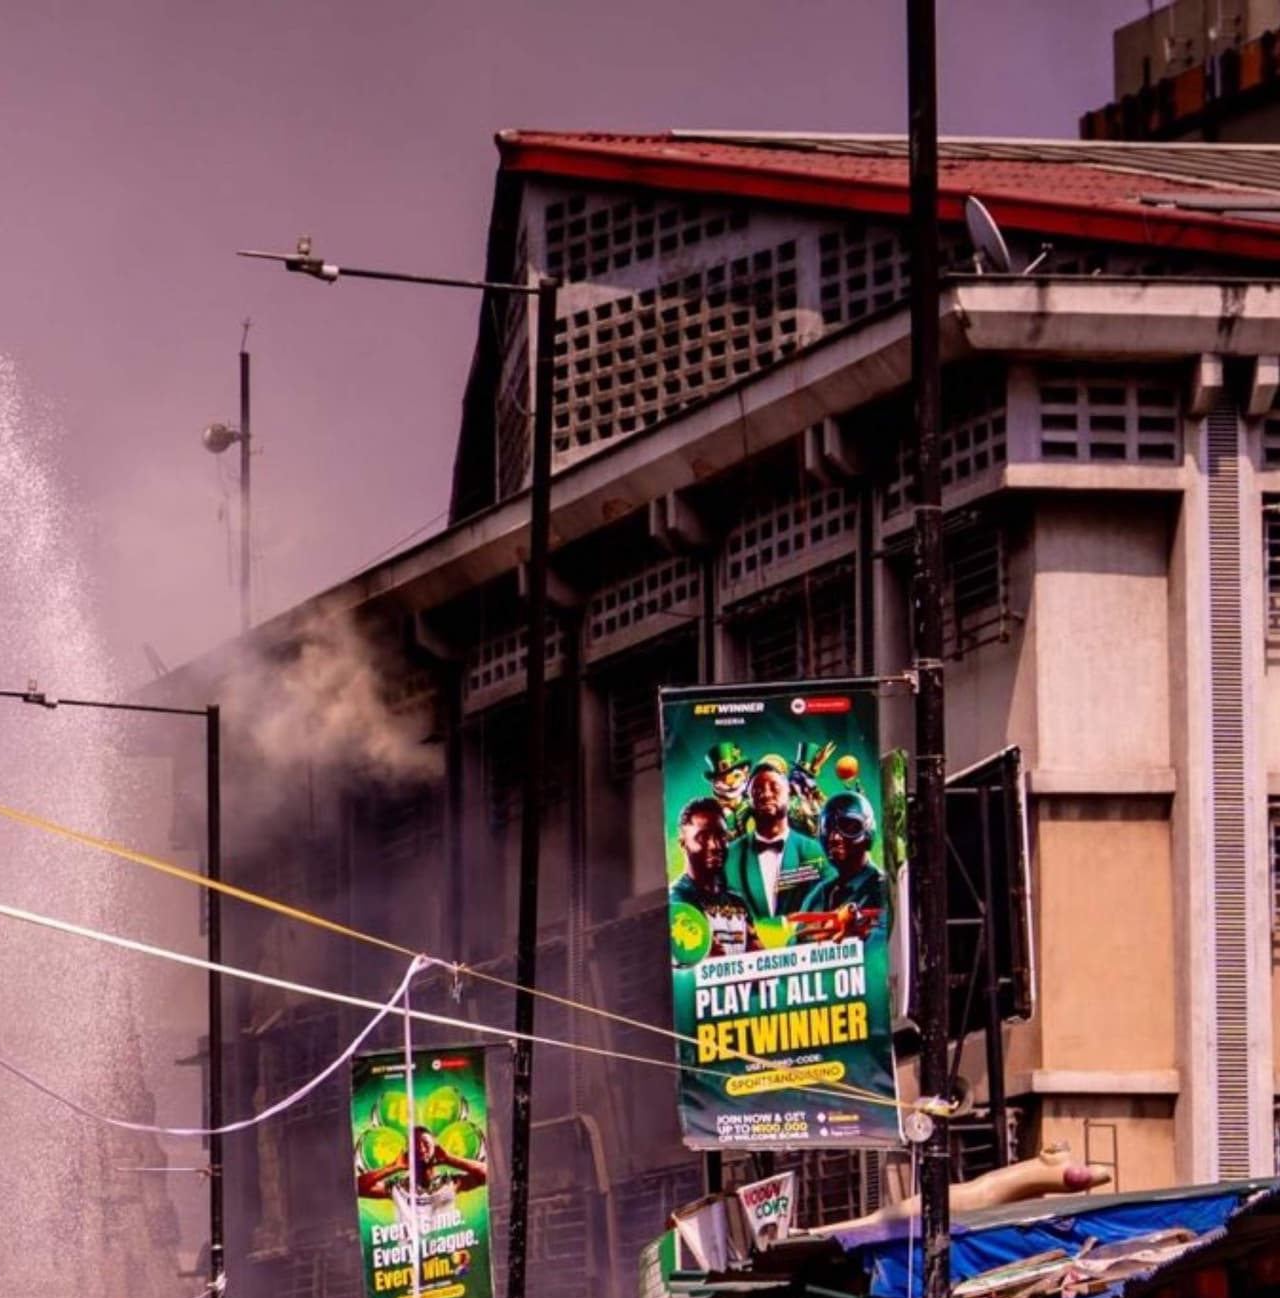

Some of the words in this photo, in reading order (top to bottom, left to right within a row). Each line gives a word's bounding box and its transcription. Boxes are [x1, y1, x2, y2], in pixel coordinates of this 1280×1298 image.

[701, 960, 744, 980] SPORTS
[756, 953, 797, 972] CASINO
[810, 943, 857, 963] AVIATOR
[696, 981, 752, 1019] PLAY
[759, 977, 780, 1010] IT
[787, 972, 828, 1006] ALL
[835, 966, 866, 998] ON
[697, 1001, 868, 1064] BETWINNER
[735, 1123, 750, 1134] TO
